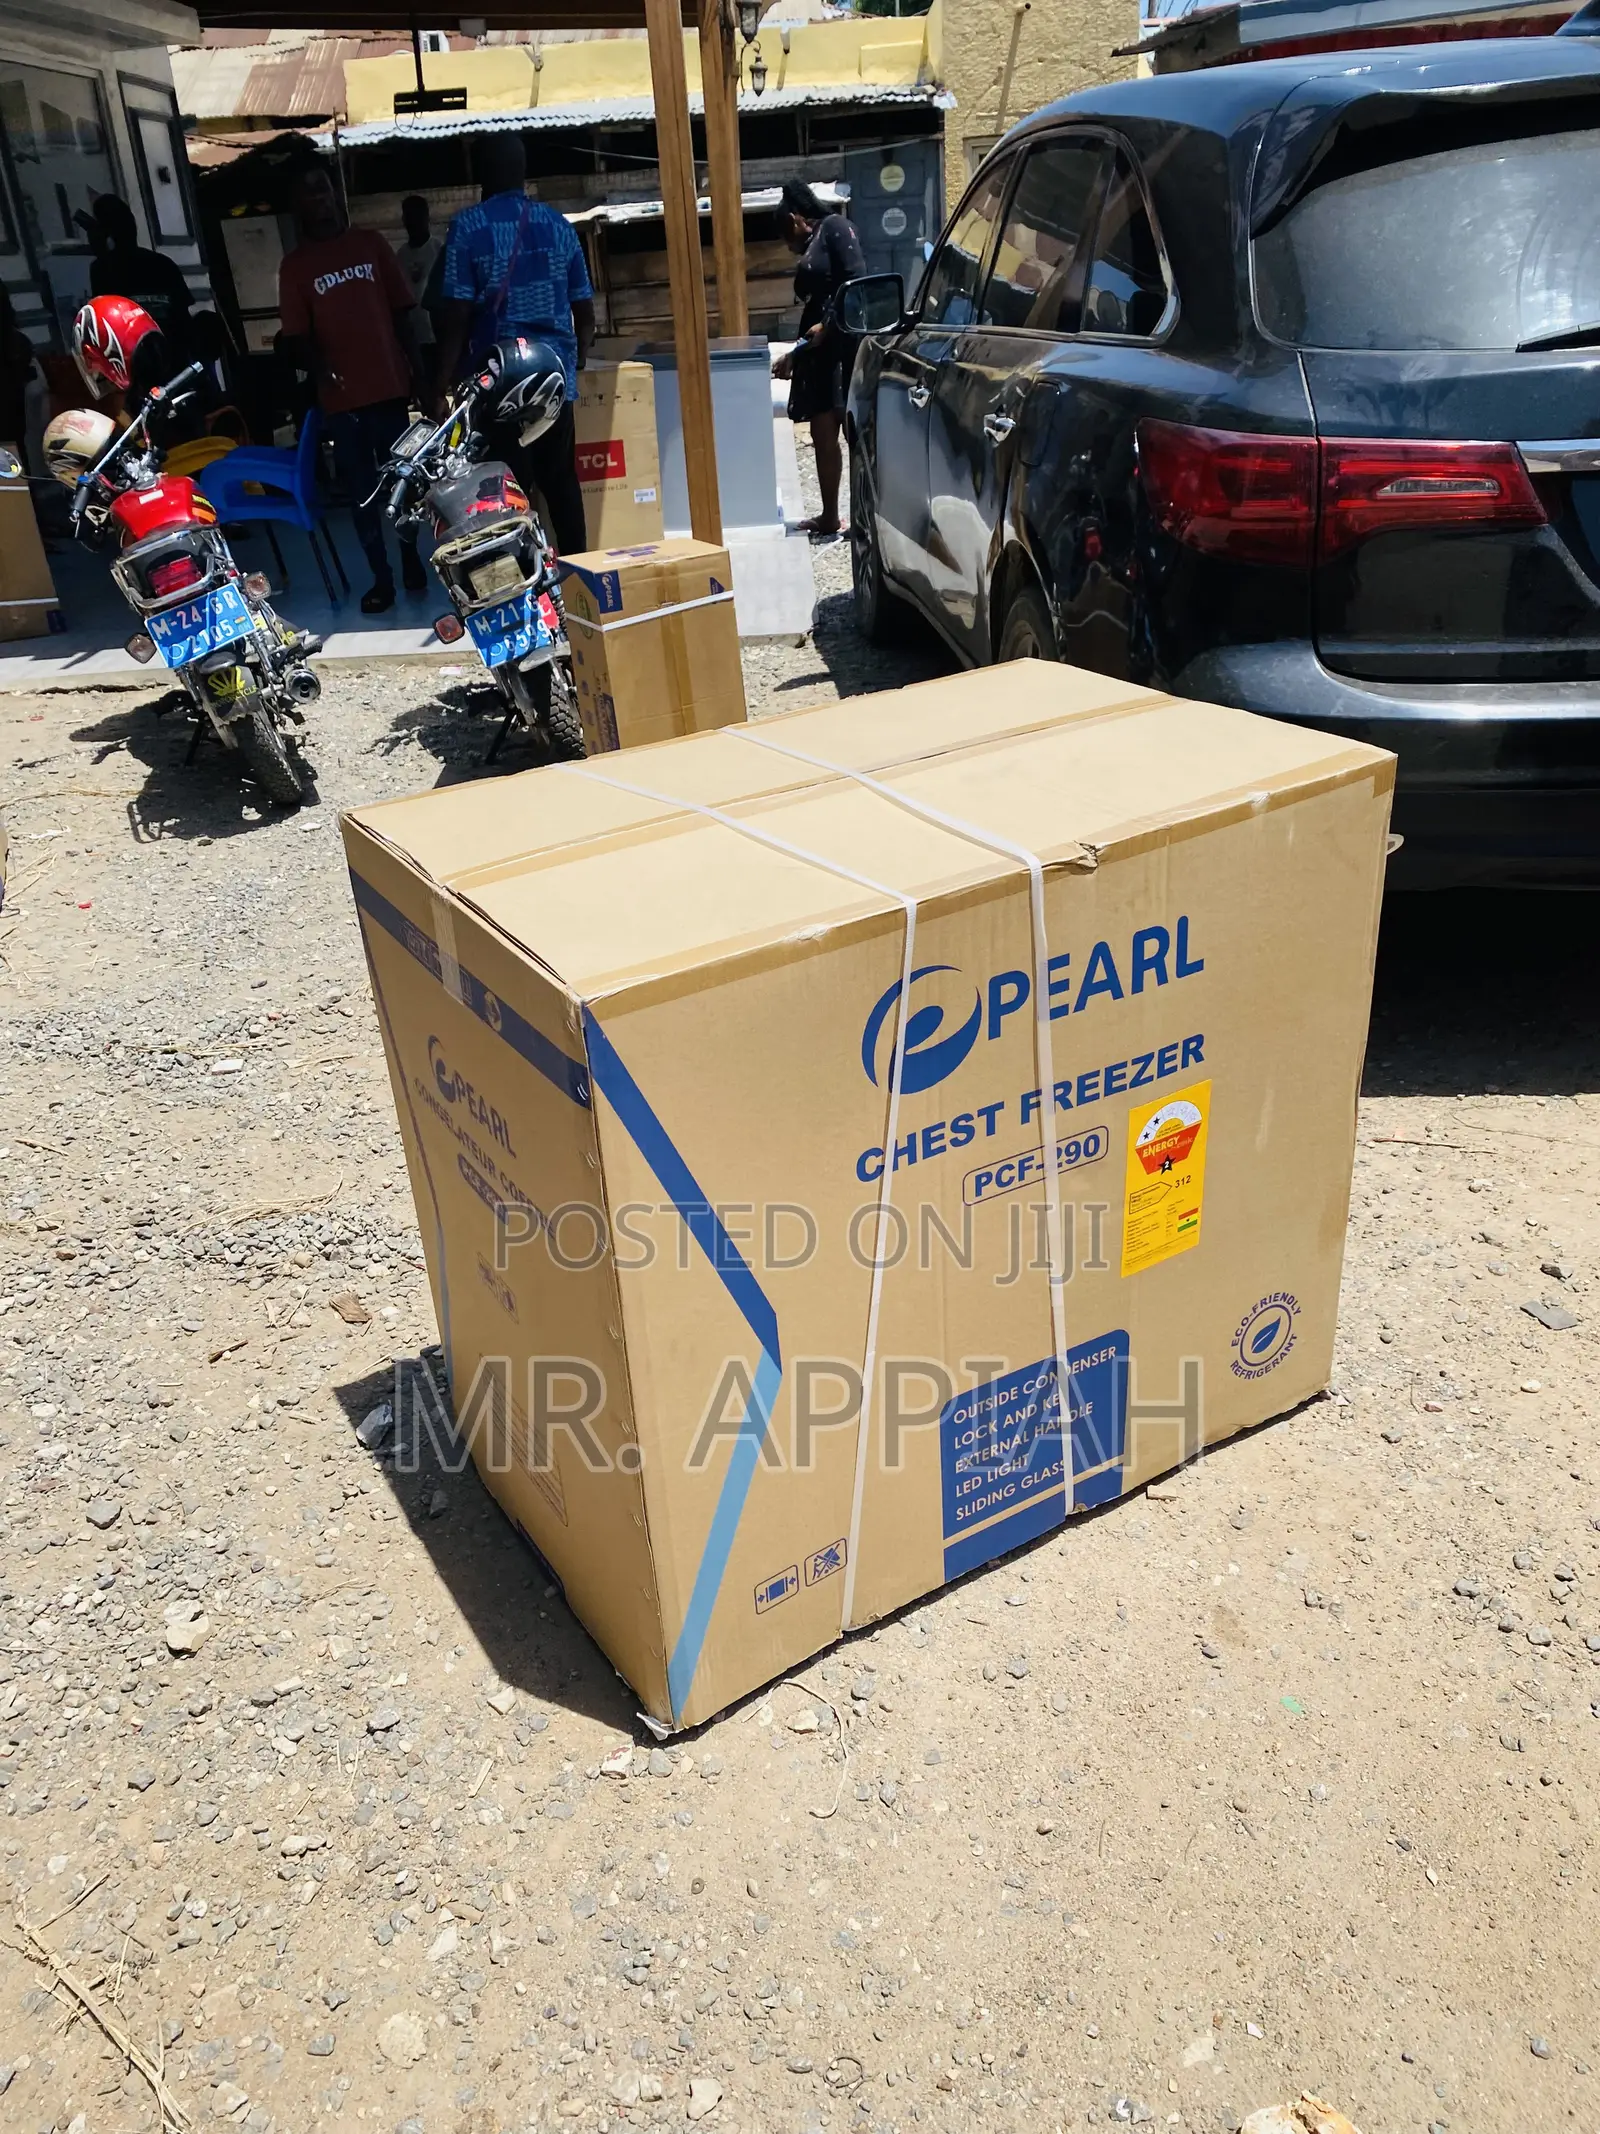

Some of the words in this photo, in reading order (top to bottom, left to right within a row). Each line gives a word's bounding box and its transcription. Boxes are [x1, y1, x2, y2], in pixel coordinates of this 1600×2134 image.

[313, 263, 374, 295] GDLUCK
[578, 453, 618, 469] TCL
[190, 619, 235, 653] 2105
[988, 915, 1205, 1041] PEARL
[453, 1069, 517, 1160] PEARL
[856, 1101, 1005, 1182] CHEST
[1020, 1033, 1205, 1126] FREEZER
[1143, 1135, 1181, 1158] ENERGY
[1164, 1160, 1170, 1169] 2
[1175, 1175, 1192, 1189] 312
[1231, 1292, 1302, 1347] ECO-FRIENDLY
[1230, 1334, 1297, 1380] REFRIGERANT
[953, 1386, 1019, 1425] OUTSIDE
[954, 1420, 998, 1449] LOCK
[1003, 1403, 1037, 1429] AND
[1042, 1393, 1060, 1412] KE
[955, 1430, 1030, 1474] EXTERNAL
[955, 1475, 982, 1498] LED
[987, 1453, 1030, 1484] LIGHT
[956, 1483, 1016, 1521] SLIDING
